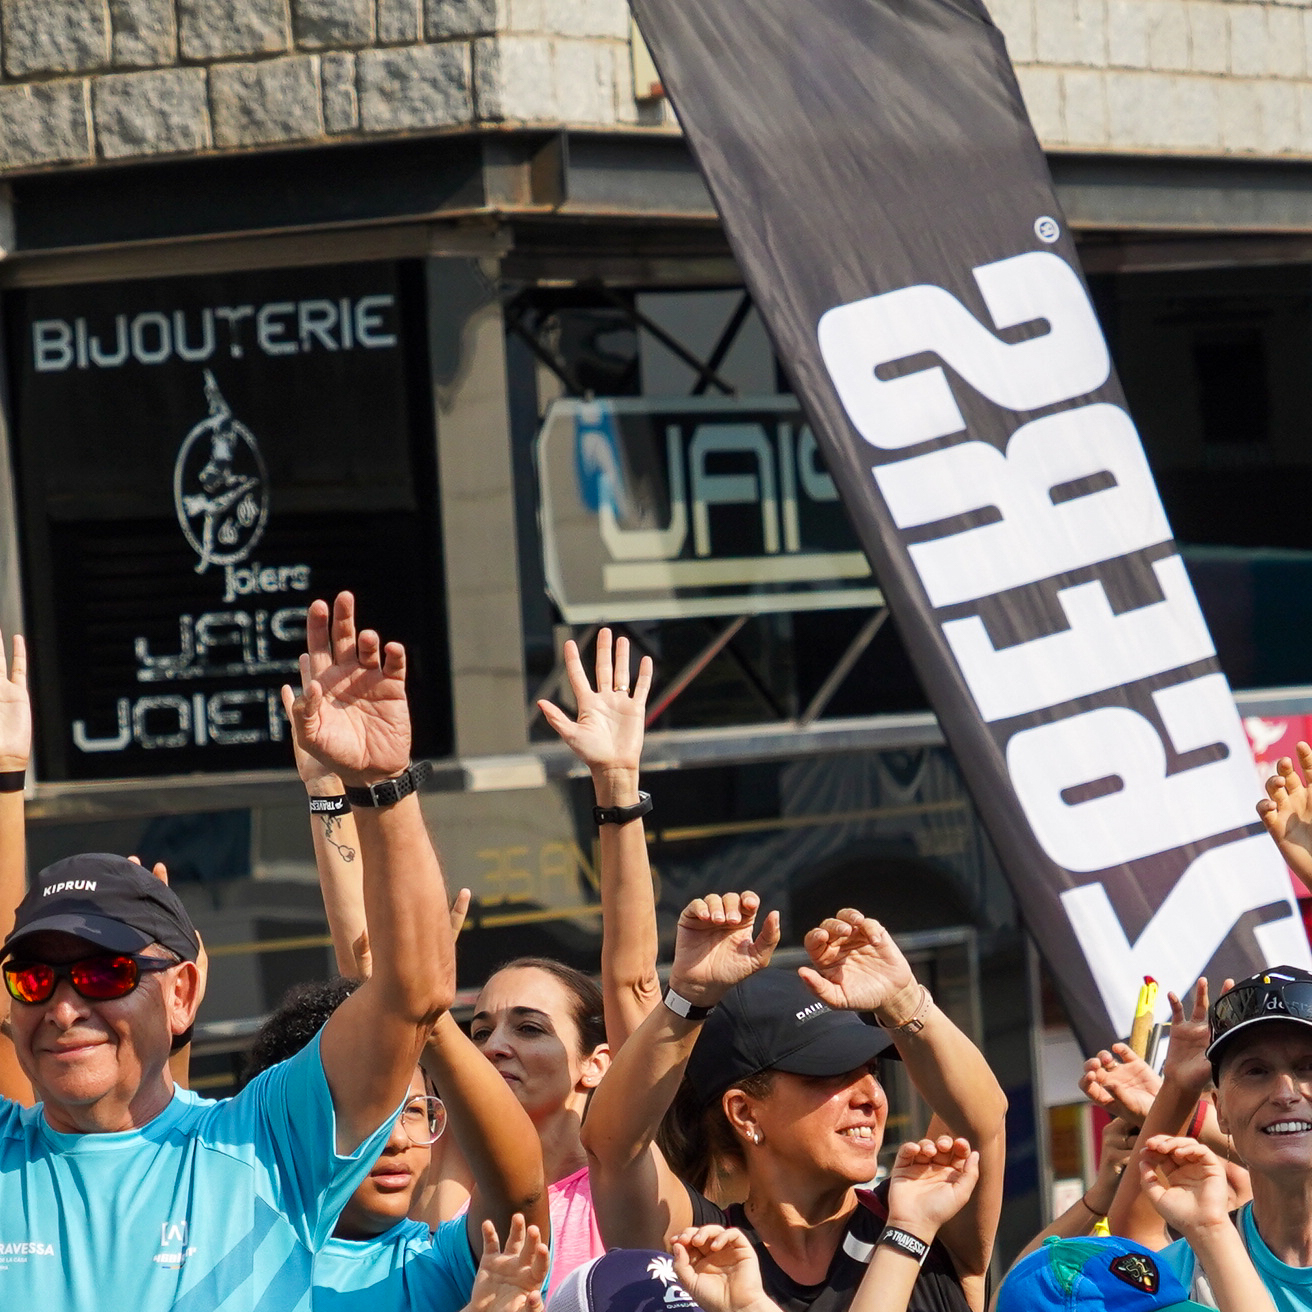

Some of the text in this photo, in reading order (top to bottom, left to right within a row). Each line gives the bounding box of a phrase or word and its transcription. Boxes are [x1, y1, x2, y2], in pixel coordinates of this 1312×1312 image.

[32, 295, 398, 373] BIJOUTERIE
[43, 880, 97, 897] KIPRUN
[892, 1230, 926, 1257] TRAVESSA
